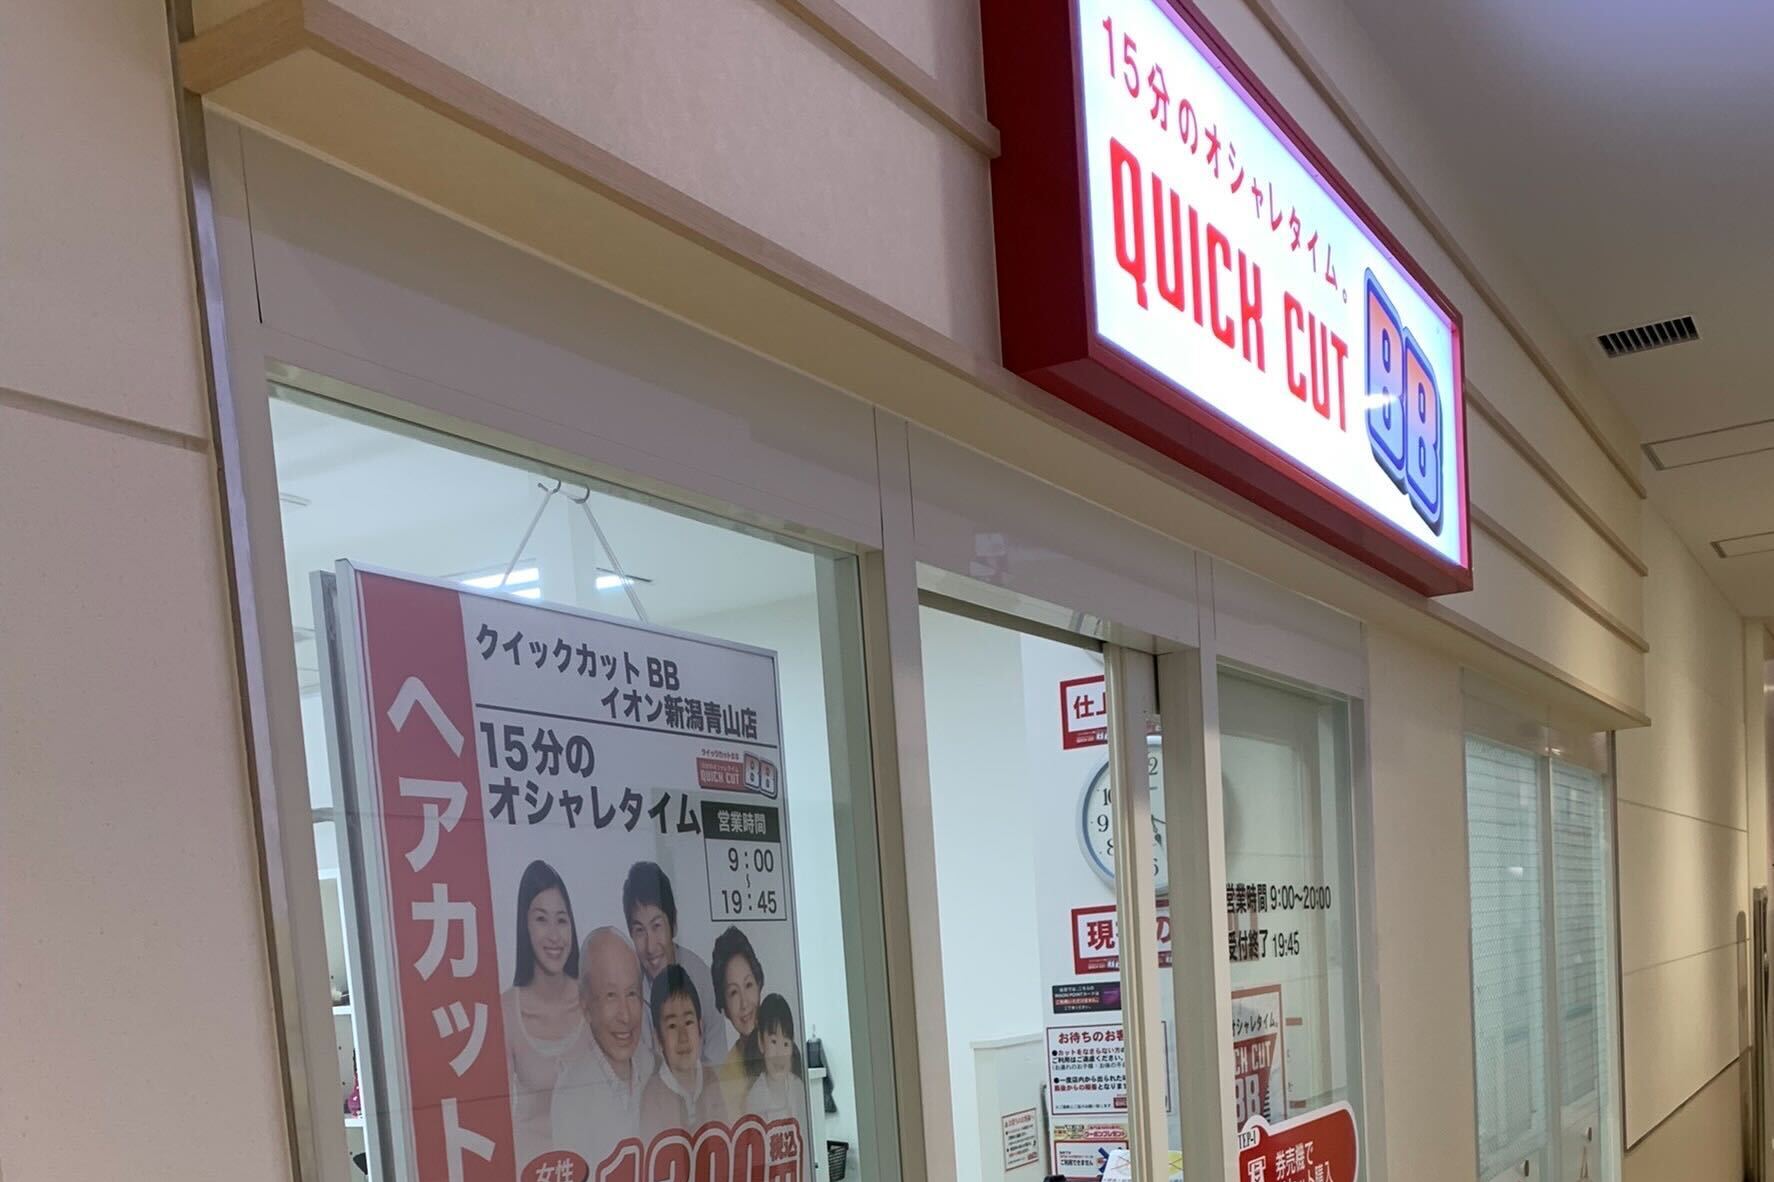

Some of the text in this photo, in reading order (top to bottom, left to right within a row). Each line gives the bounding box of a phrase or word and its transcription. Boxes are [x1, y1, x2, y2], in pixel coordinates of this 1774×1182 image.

[1102, 16, 1348, 304] 15分のオシャレタイム。
[1109, 136, 1443, 536] QUICK CUT BB
[476, 623, 681, 692] クイックカット BB
[601, 687, 759, 740] イオン新潟青山店
[480, 721, 596, 778] 15分の
[487, 776, 702, 834] オシャレタイム
[717, 809, 767, 835] 営業時間
[728, 848, 775, 873] 9:00
[721, 890, 778, 914] 19:45
[1226, 883, 1268, 913] 営業時間
[1228, 929, 1301, 960] 受付終了 19:45
[1251, 1040, 1271, 1071] CUT
[769, 1130, 799, 1161] 税込
[1275, 1141, 1314, 1181] 券売機で
